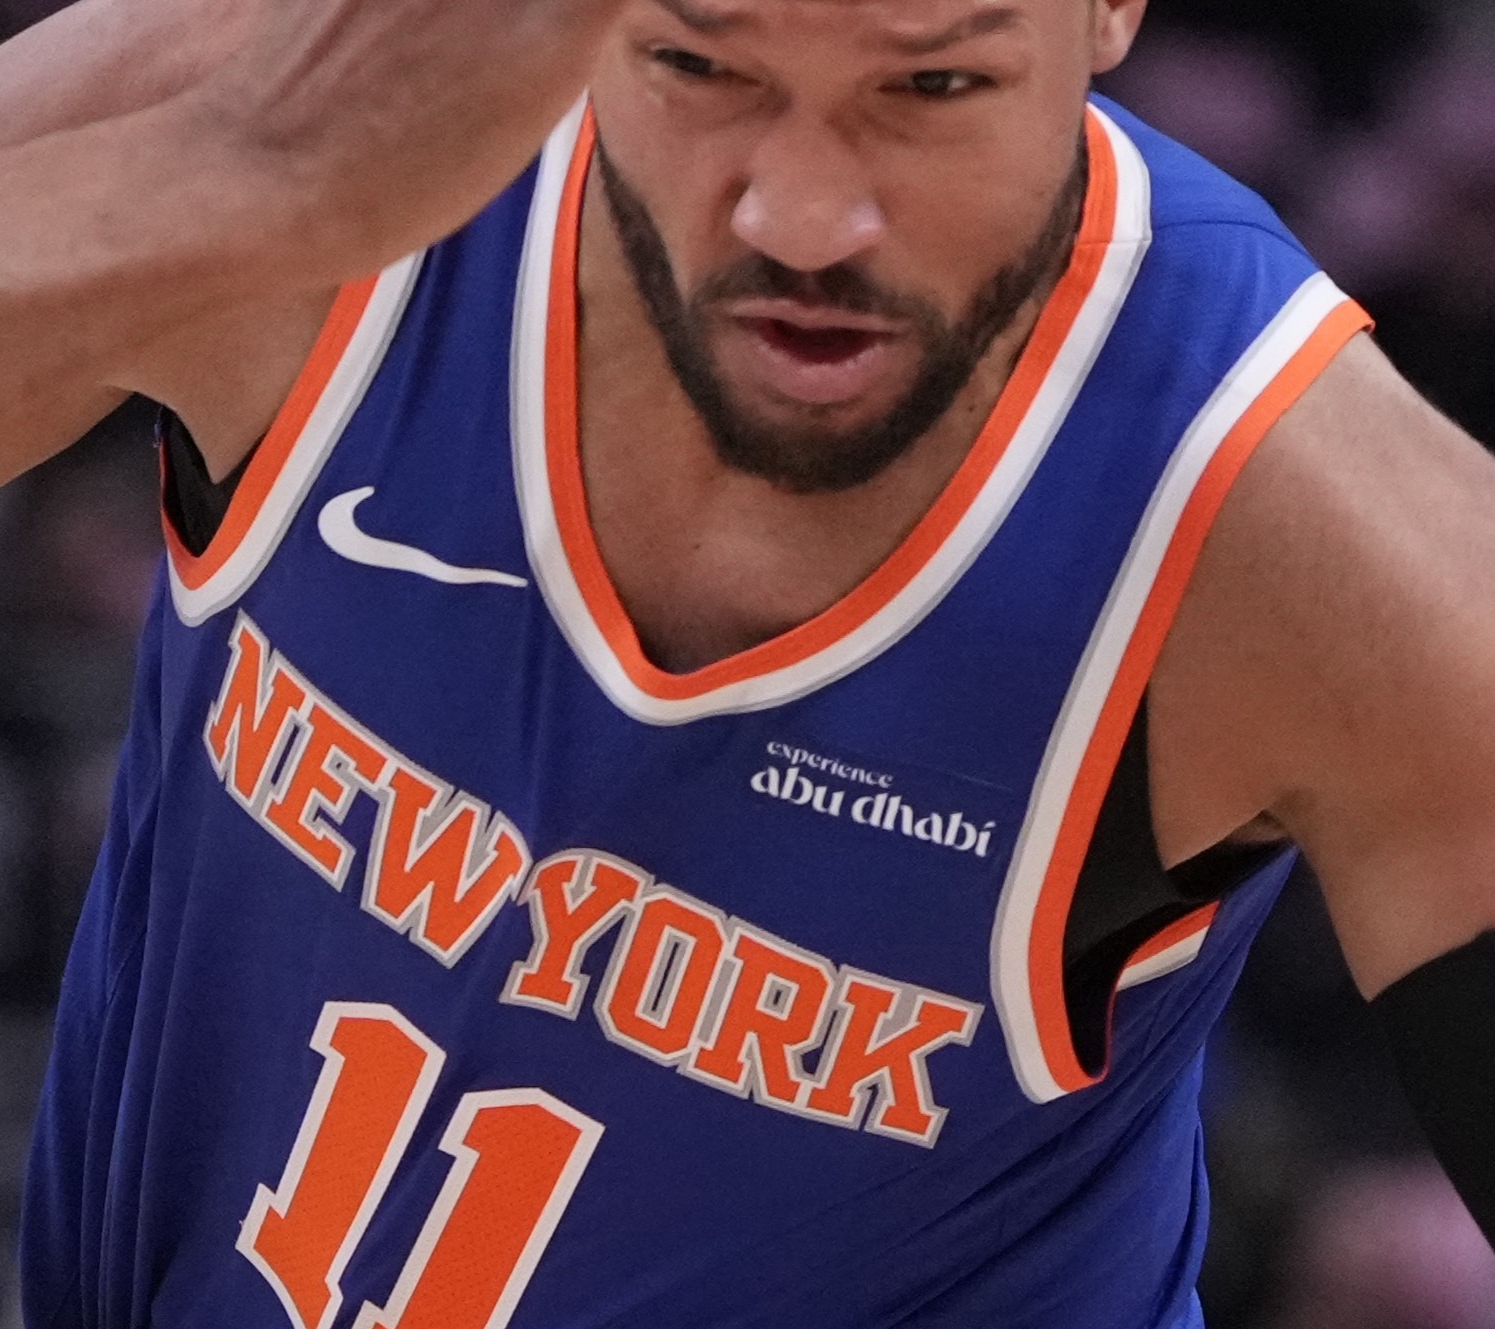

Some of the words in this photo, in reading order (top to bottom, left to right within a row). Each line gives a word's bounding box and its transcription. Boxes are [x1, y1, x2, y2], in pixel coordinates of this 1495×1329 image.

[766, 741, 894, 789] experience
[750, 766, 845, 817] abu
[204, 608, 533, 969] NEW
[499, 847, 985, 1150] YORK
